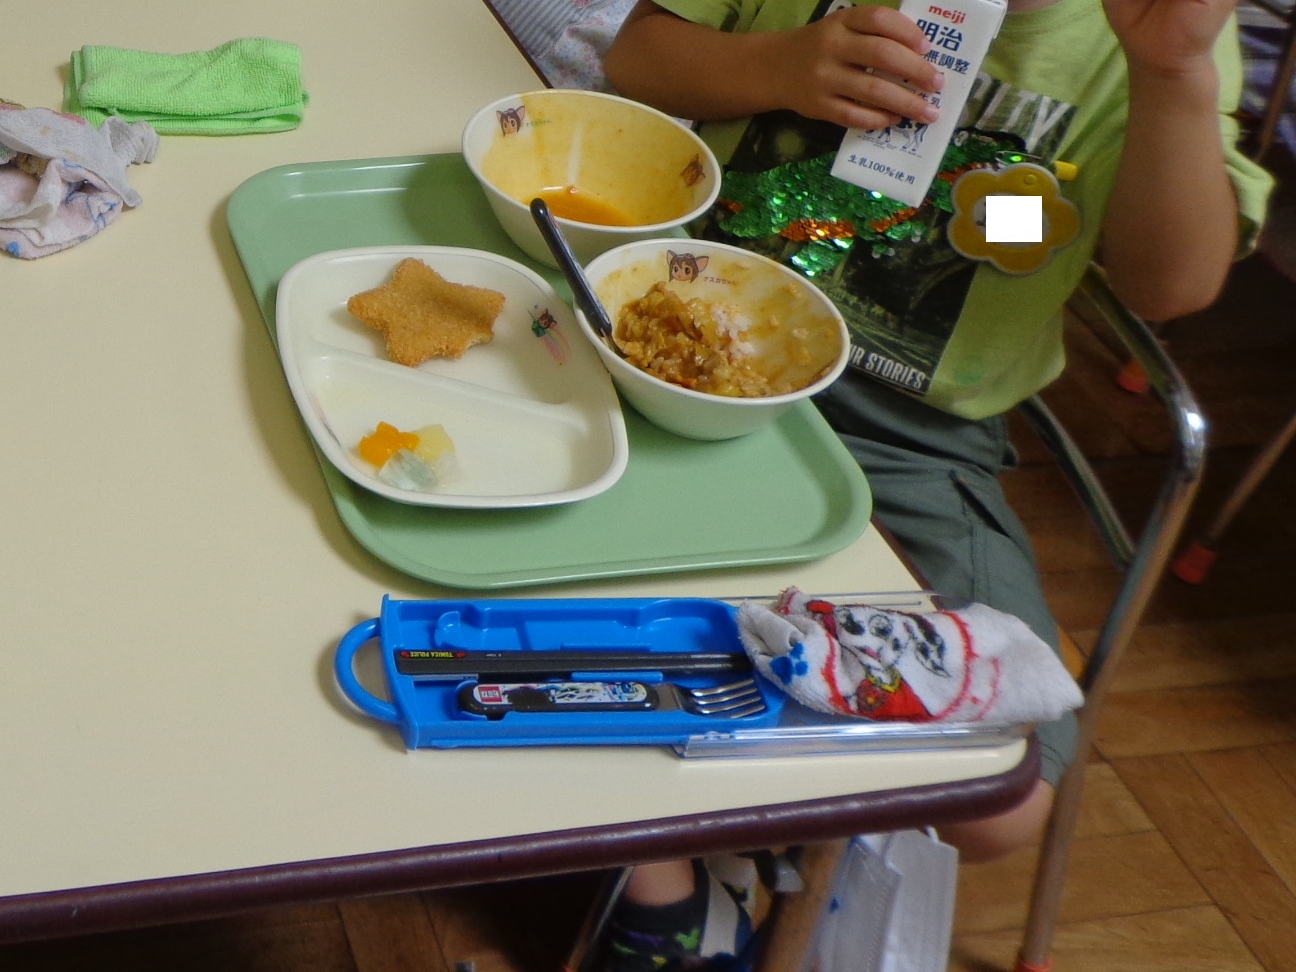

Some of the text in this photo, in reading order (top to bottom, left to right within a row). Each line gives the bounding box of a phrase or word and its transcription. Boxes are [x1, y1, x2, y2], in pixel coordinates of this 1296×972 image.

[928, 4, 966, 24] meiji
[916, 19, 963, 52] 明治
[924, 49, 971, 75] 無調整
[848, 154, 915, 185] 生乳100%使用
[865, 352, 926, 389] STORIES
